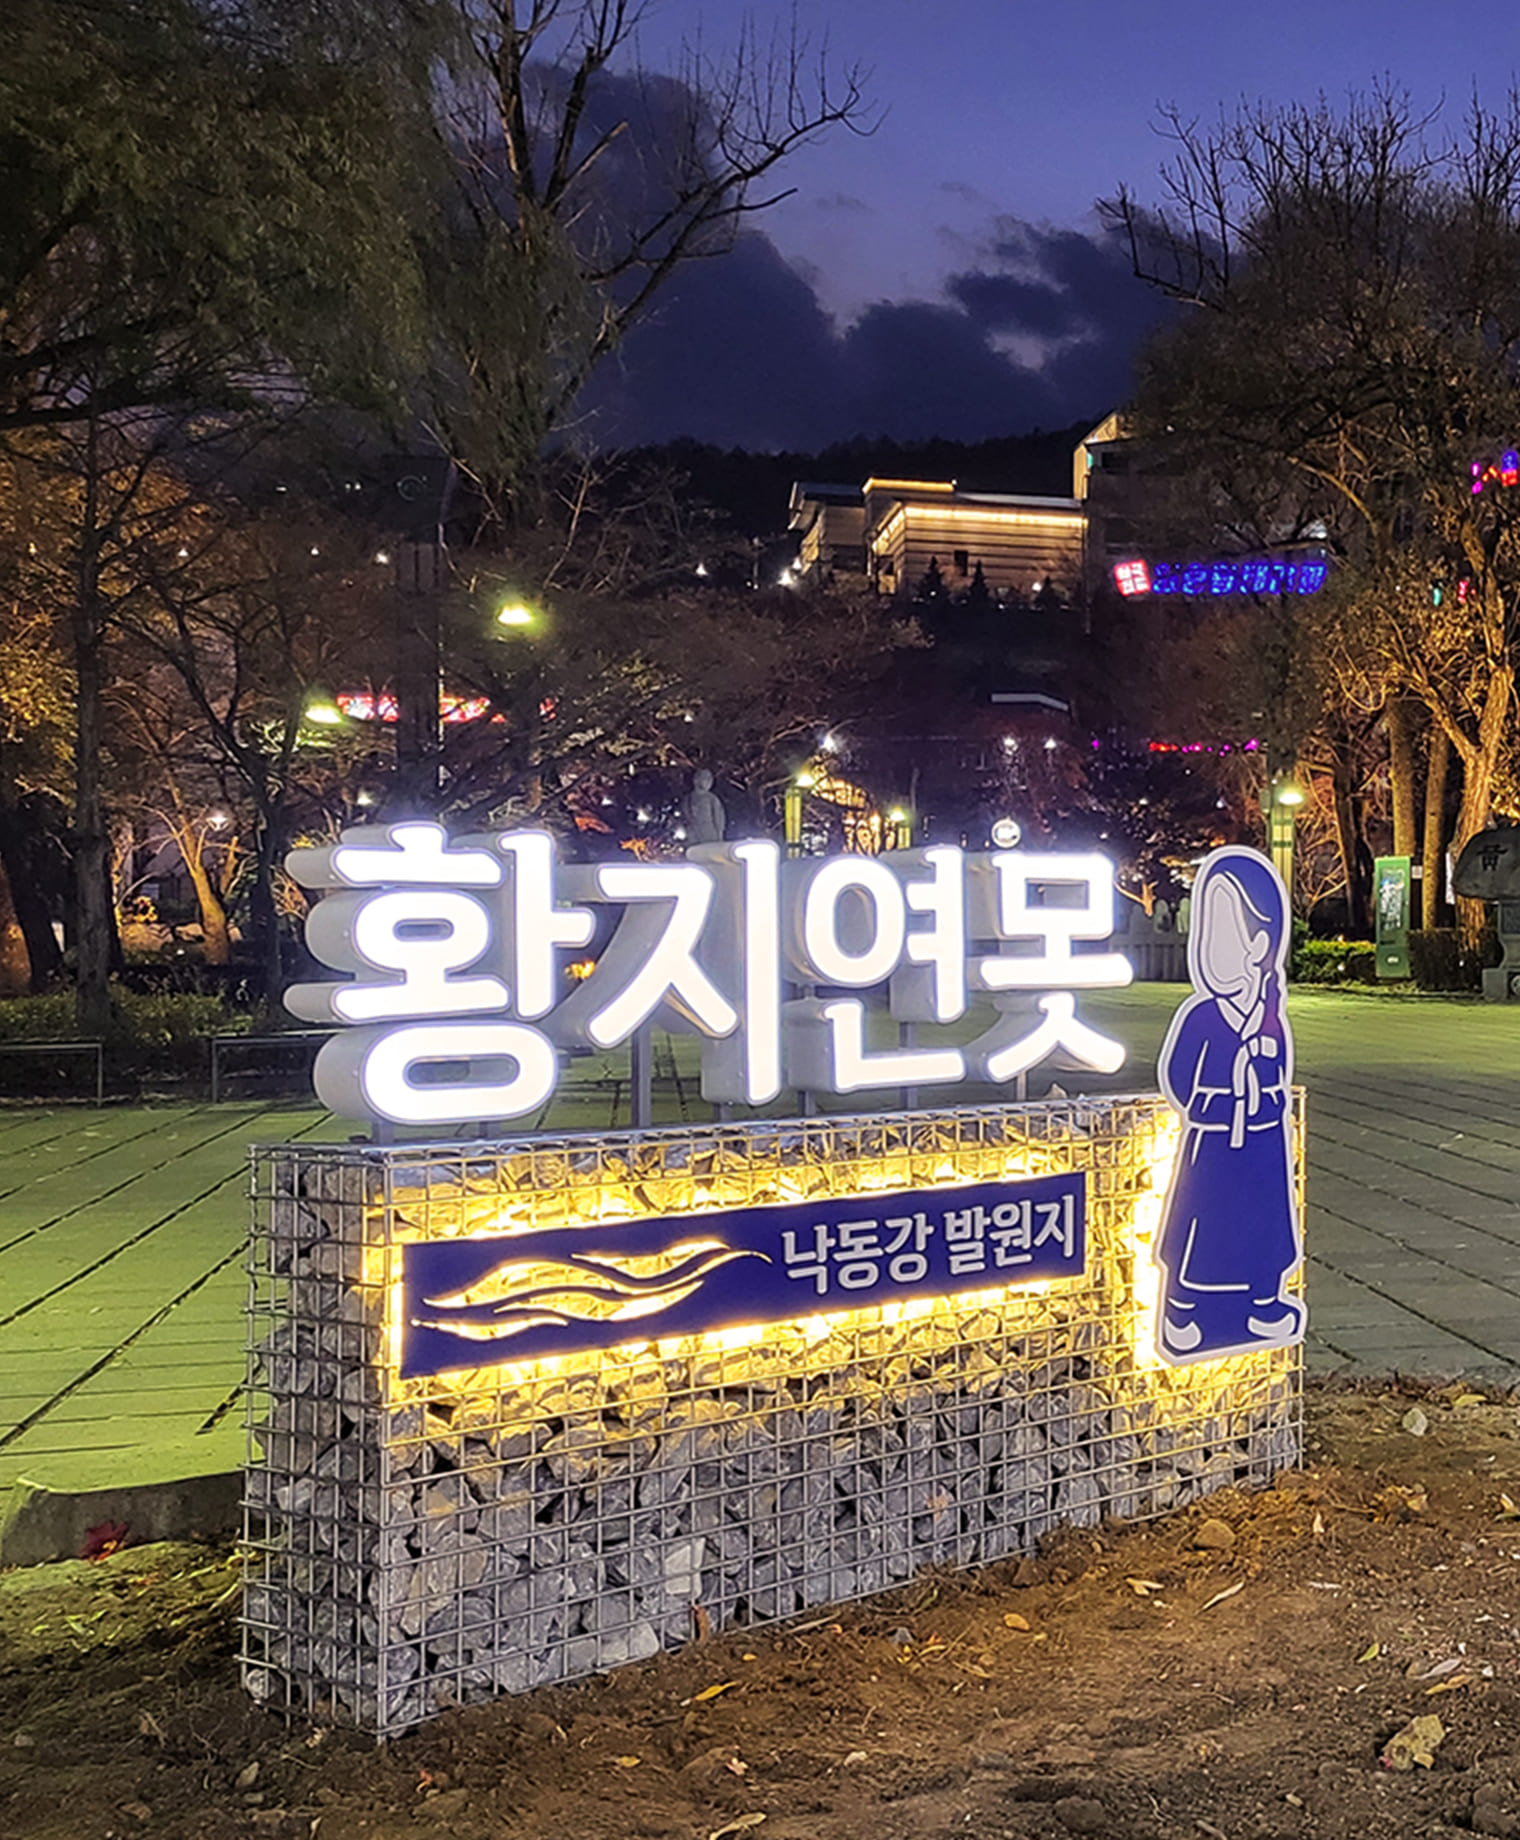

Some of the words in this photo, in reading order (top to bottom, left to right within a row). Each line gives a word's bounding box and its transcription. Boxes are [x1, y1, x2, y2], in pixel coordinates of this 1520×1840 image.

[333, 820, 1135, 1124] 황지연못
[780, 1212, 935, 1296] 낙동강
[943, 1194, 1076, 1276] 발원지
